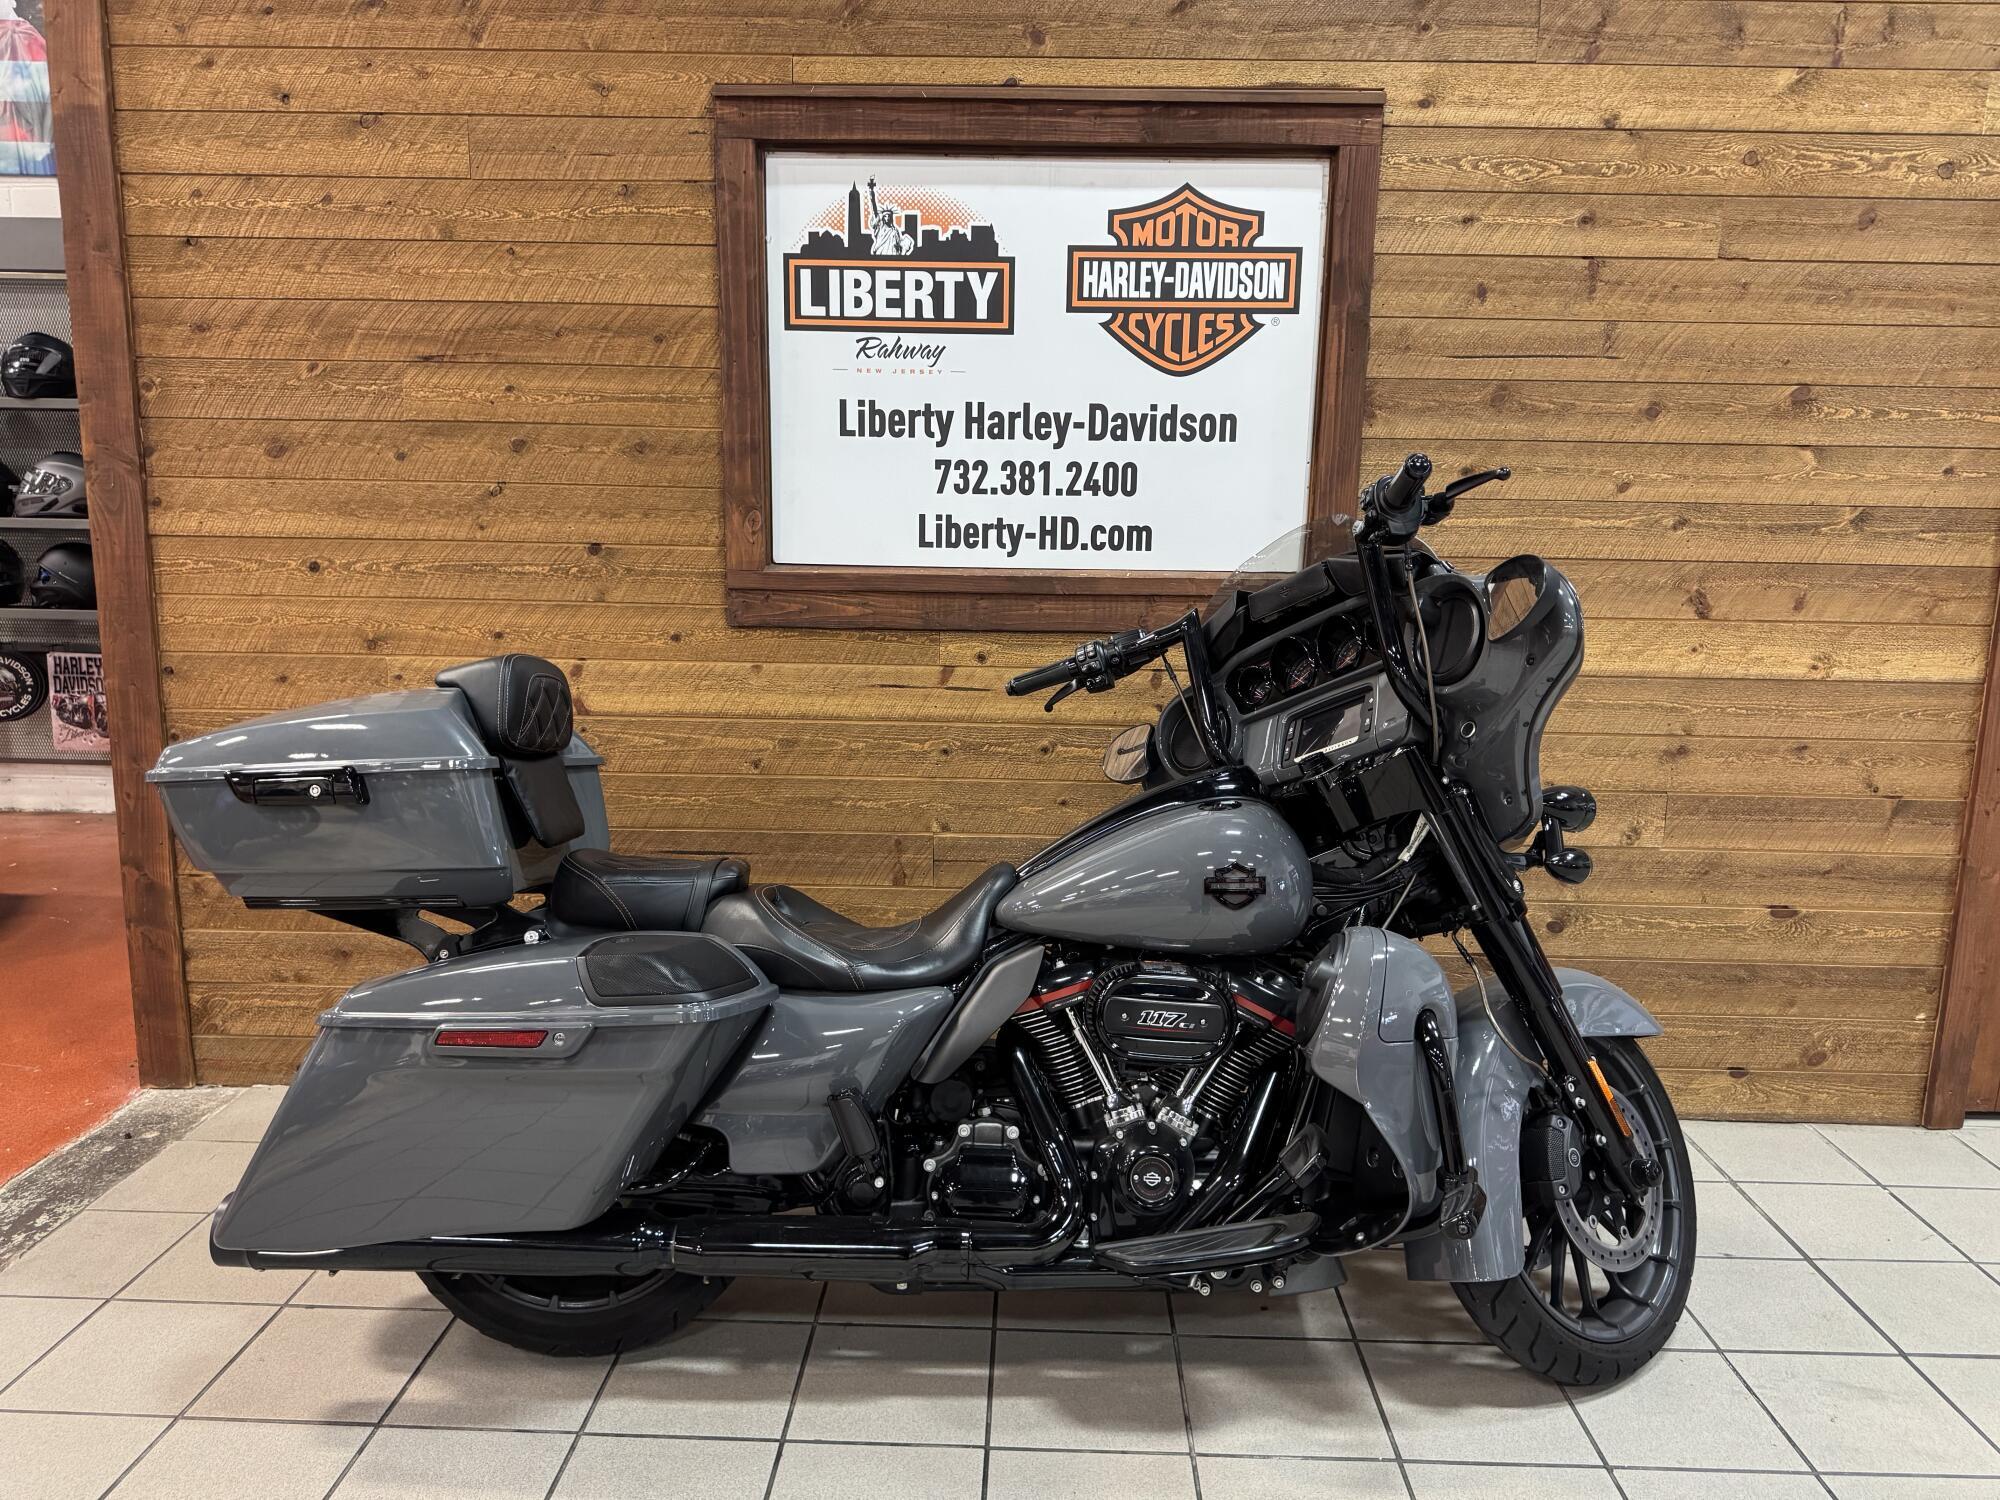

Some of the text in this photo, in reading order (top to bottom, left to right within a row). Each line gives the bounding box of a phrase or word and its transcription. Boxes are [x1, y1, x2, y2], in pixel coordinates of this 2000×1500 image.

[1132, 203, 1239, 247] MOTOR
[799, 268, 999, 320] LIBERTY
[1082, 260, 1286, 300] HARLEY-DAVIDSON
[855, 335, 947, 368] Rahway
[1128, 312, 1235, 362] CYCLES
[838, 398, 1238, 450] Liberty Harley-Davidson
[934, 459, 1138, 498] 732.381.2400
[918, 513, 1153, 558] Liberty-HD.com
[53, 656, 102, 675] HARLEY
[0, 693, 33, 718] CYCLES
[1137, 1009, 1188, 1028] 117
